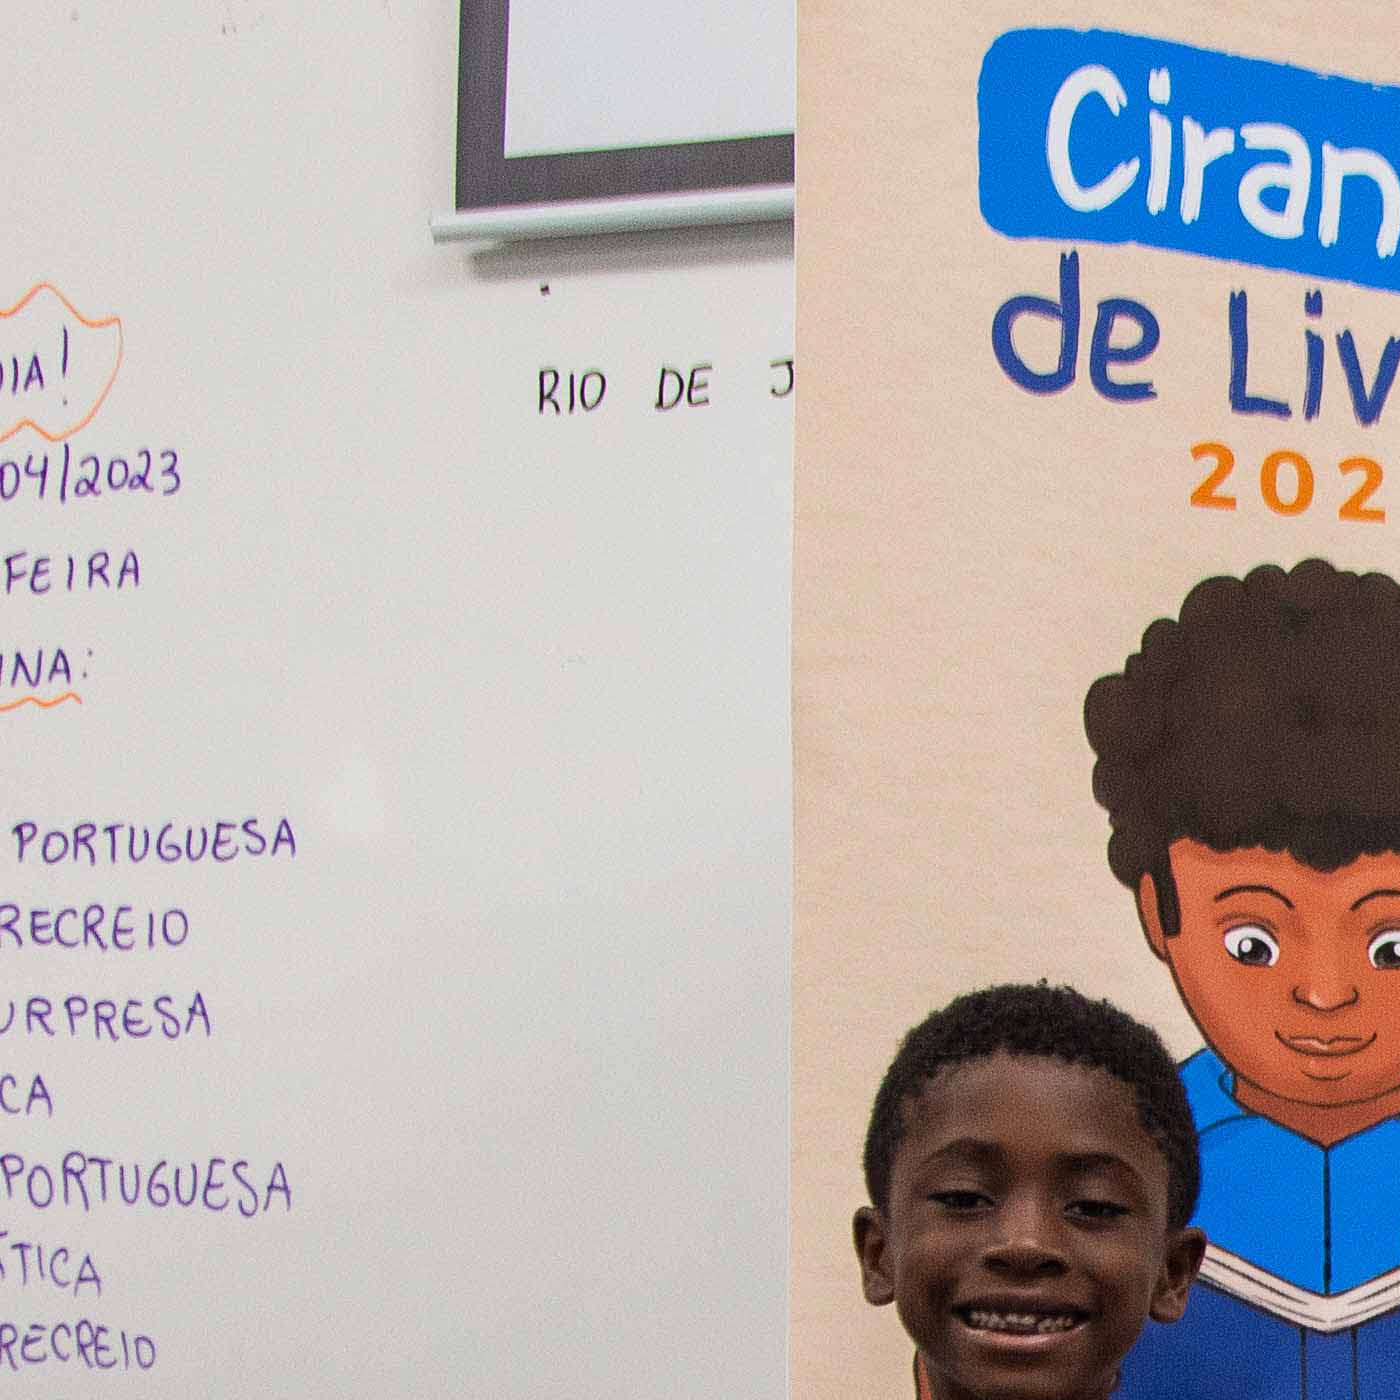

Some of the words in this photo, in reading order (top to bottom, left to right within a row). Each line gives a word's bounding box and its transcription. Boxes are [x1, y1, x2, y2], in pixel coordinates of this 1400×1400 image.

[991, 250, 1161, 404] de
[539, 366, 608, 416] RIO
[655, 363, 713, 411] DE
[0, 442, 182, 504] 04/2023
[5, 547, 140, 595] FEIRA
[12, 817, 297, 867] PORTUGUESA
[0, 903, 190, 952] RECREIO
[0, 1151, 293, 1217] PORTUGUESA
[0, 1319, 156, 1372] RECREIO
